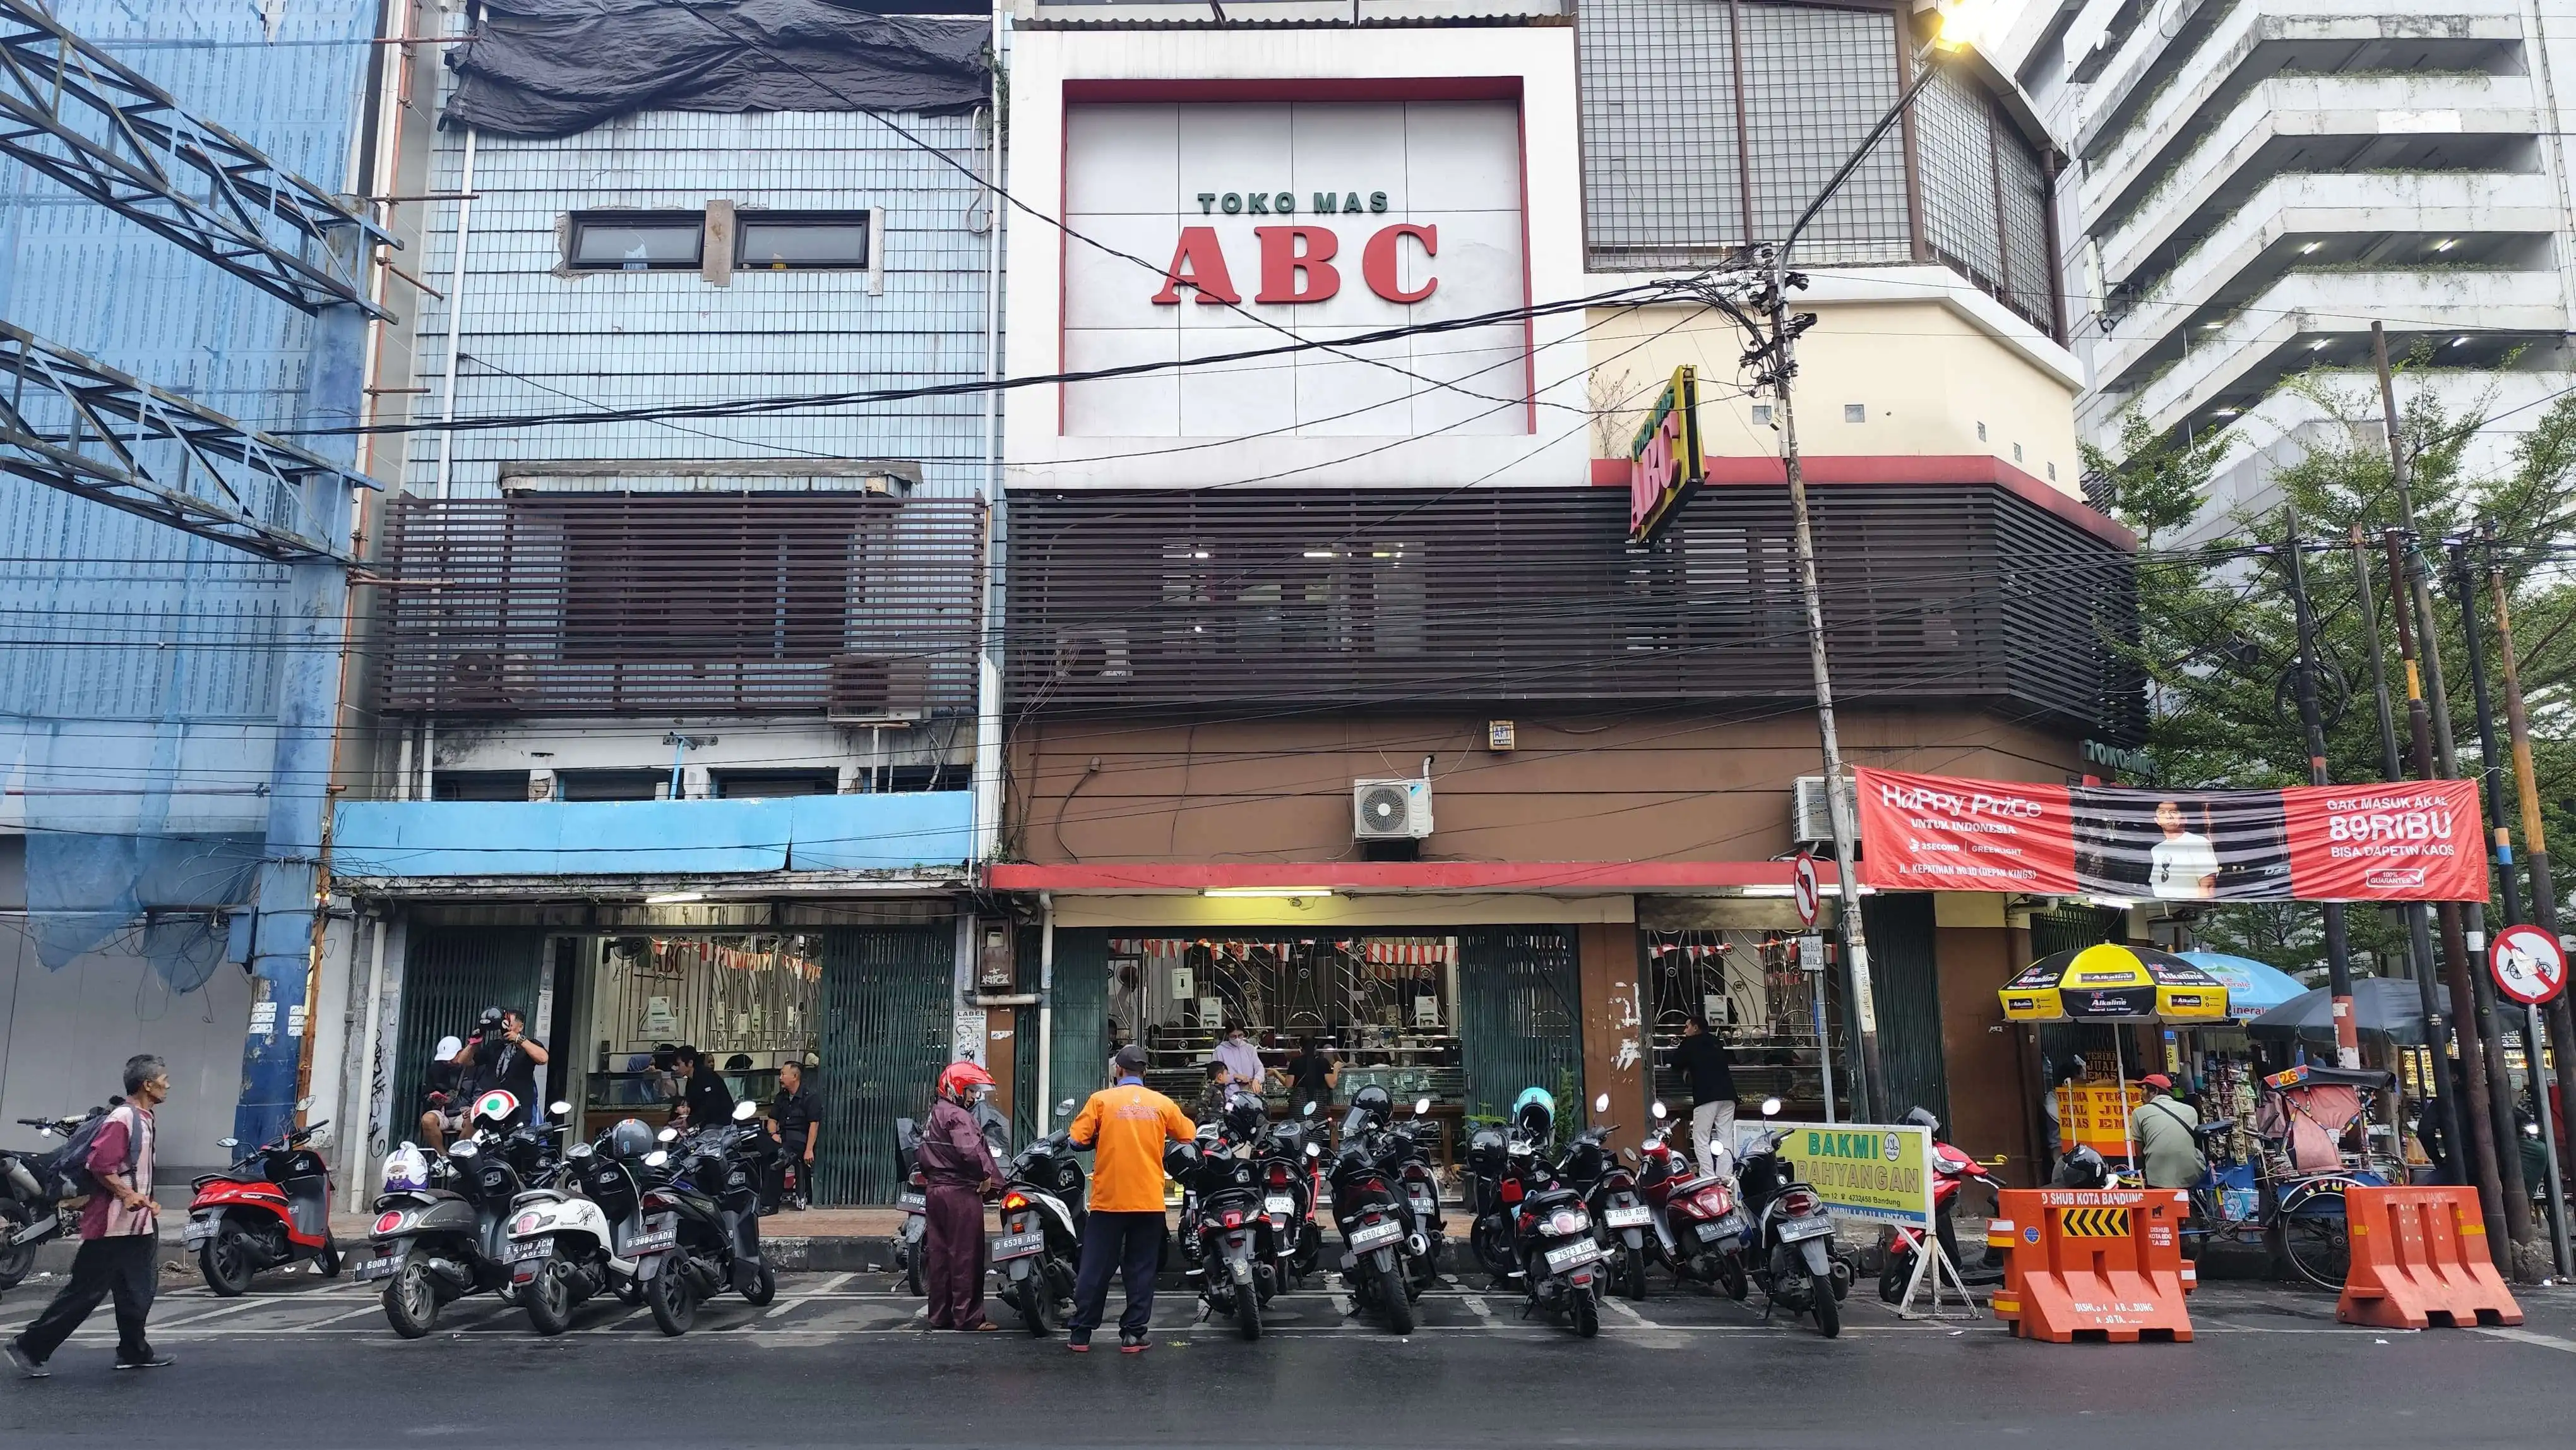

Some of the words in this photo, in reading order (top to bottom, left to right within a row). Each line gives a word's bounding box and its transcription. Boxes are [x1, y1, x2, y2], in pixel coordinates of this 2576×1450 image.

[1198, 191, 1296, 213] TOKO
[1313, 191, 1388, 213] MAS
[1151, 223, 1438, 305] ABC
[1630, 410, 1681, 534] ABC
[2079, 739, 2126, 770] TOKO
[2129, 753, 2159, 779] MAS
[2327, 800, 2357, 810] GAK
[2361, 798, 2411, 810] MASUK
[2414, 796, 2448, 809] AKAL
[1911, 818, 1950, 830] UNTUK
[1952, 821, 2018, 834] INDONESIA
[2329, 810, 2452, 841] 89RIBU
[1972, 845, 2023, 856] GREENLIGHT
[2331, 846, 2362, 858] BISA
[2363, 845, 2419, 858] DAPETIN
[2422, 844, 2454, 856] KAOS
[1912, 865, 1954, 875] KEPATIHAN
[2008, 870, 2038, 880] KINGS)
[2017, 973, 2060, 983] Alkaline
[2158, 971, 2205, 980] Alkaline
[2092, 998, 2126, 1006] Alkaline
[2233, 1005, 2266, 1016] ineral
[2086, 1061, 2118, 1072] JUAL
[2086, 1071, 2118, 1080] EMAS
[2280, 1070, 2298, 1084] 26
[2094, 1092, 2142, 1103] TERIM
[2061, 1105, 2087, 1115] JUAL
[1808, 1132, 1878, 1159] BAKMI
[1797, 1160, 1919, 1193] RAHYANGAN
[1873, 1196, 1901, 1207] Bandung
[2077, 1192, 2101, 1205] KOTA
[2102, 1192, 2144, 1205] BANDUNG
[1636, 1207, 1647, 1216] AEP
[1726, 1218, 1739, 1227] AAV
[658, 1231, 673, 1241] ADA
[1384, 1225, 1398, 1234] SBU
[506, 1247, 511, 1255] D
[535, 1238, 552, 1249] ACW
[996, 1242, 1000, 1250] D
[1549, 1254, 1555, 1262] D
[1558, 1248, 1577, 1259] 2923
[1580, 1241, 1595, 1252] ACF
[356, 1262, 362, 1271] D
[367, 1258, 387, 1269] 6000
